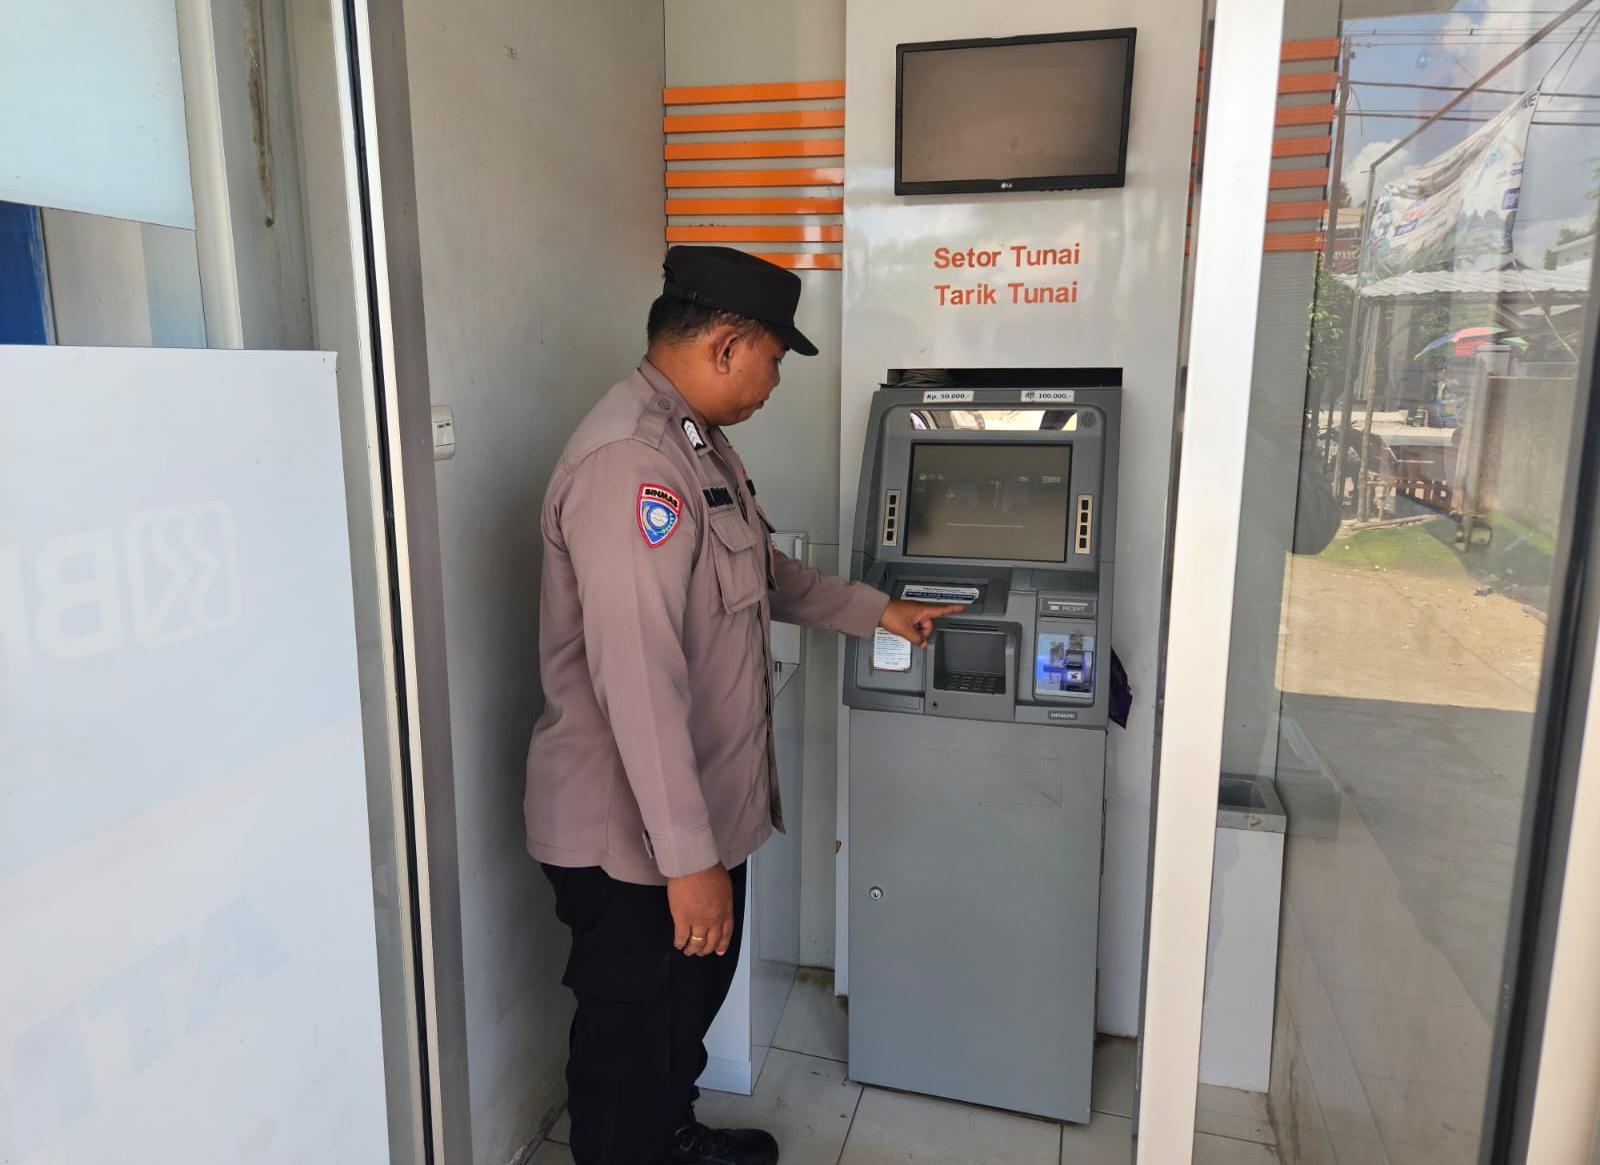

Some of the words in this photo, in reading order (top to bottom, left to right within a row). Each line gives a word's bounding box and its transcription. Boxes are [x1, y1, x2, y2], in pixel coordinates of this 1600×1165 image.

[934, 247, 1002, 269] Setor
[1010, 243, 1080, 268] Tunai
[934, 283, 997, 306] Tarik
[1007, 280, 1078, 304] Tunai
